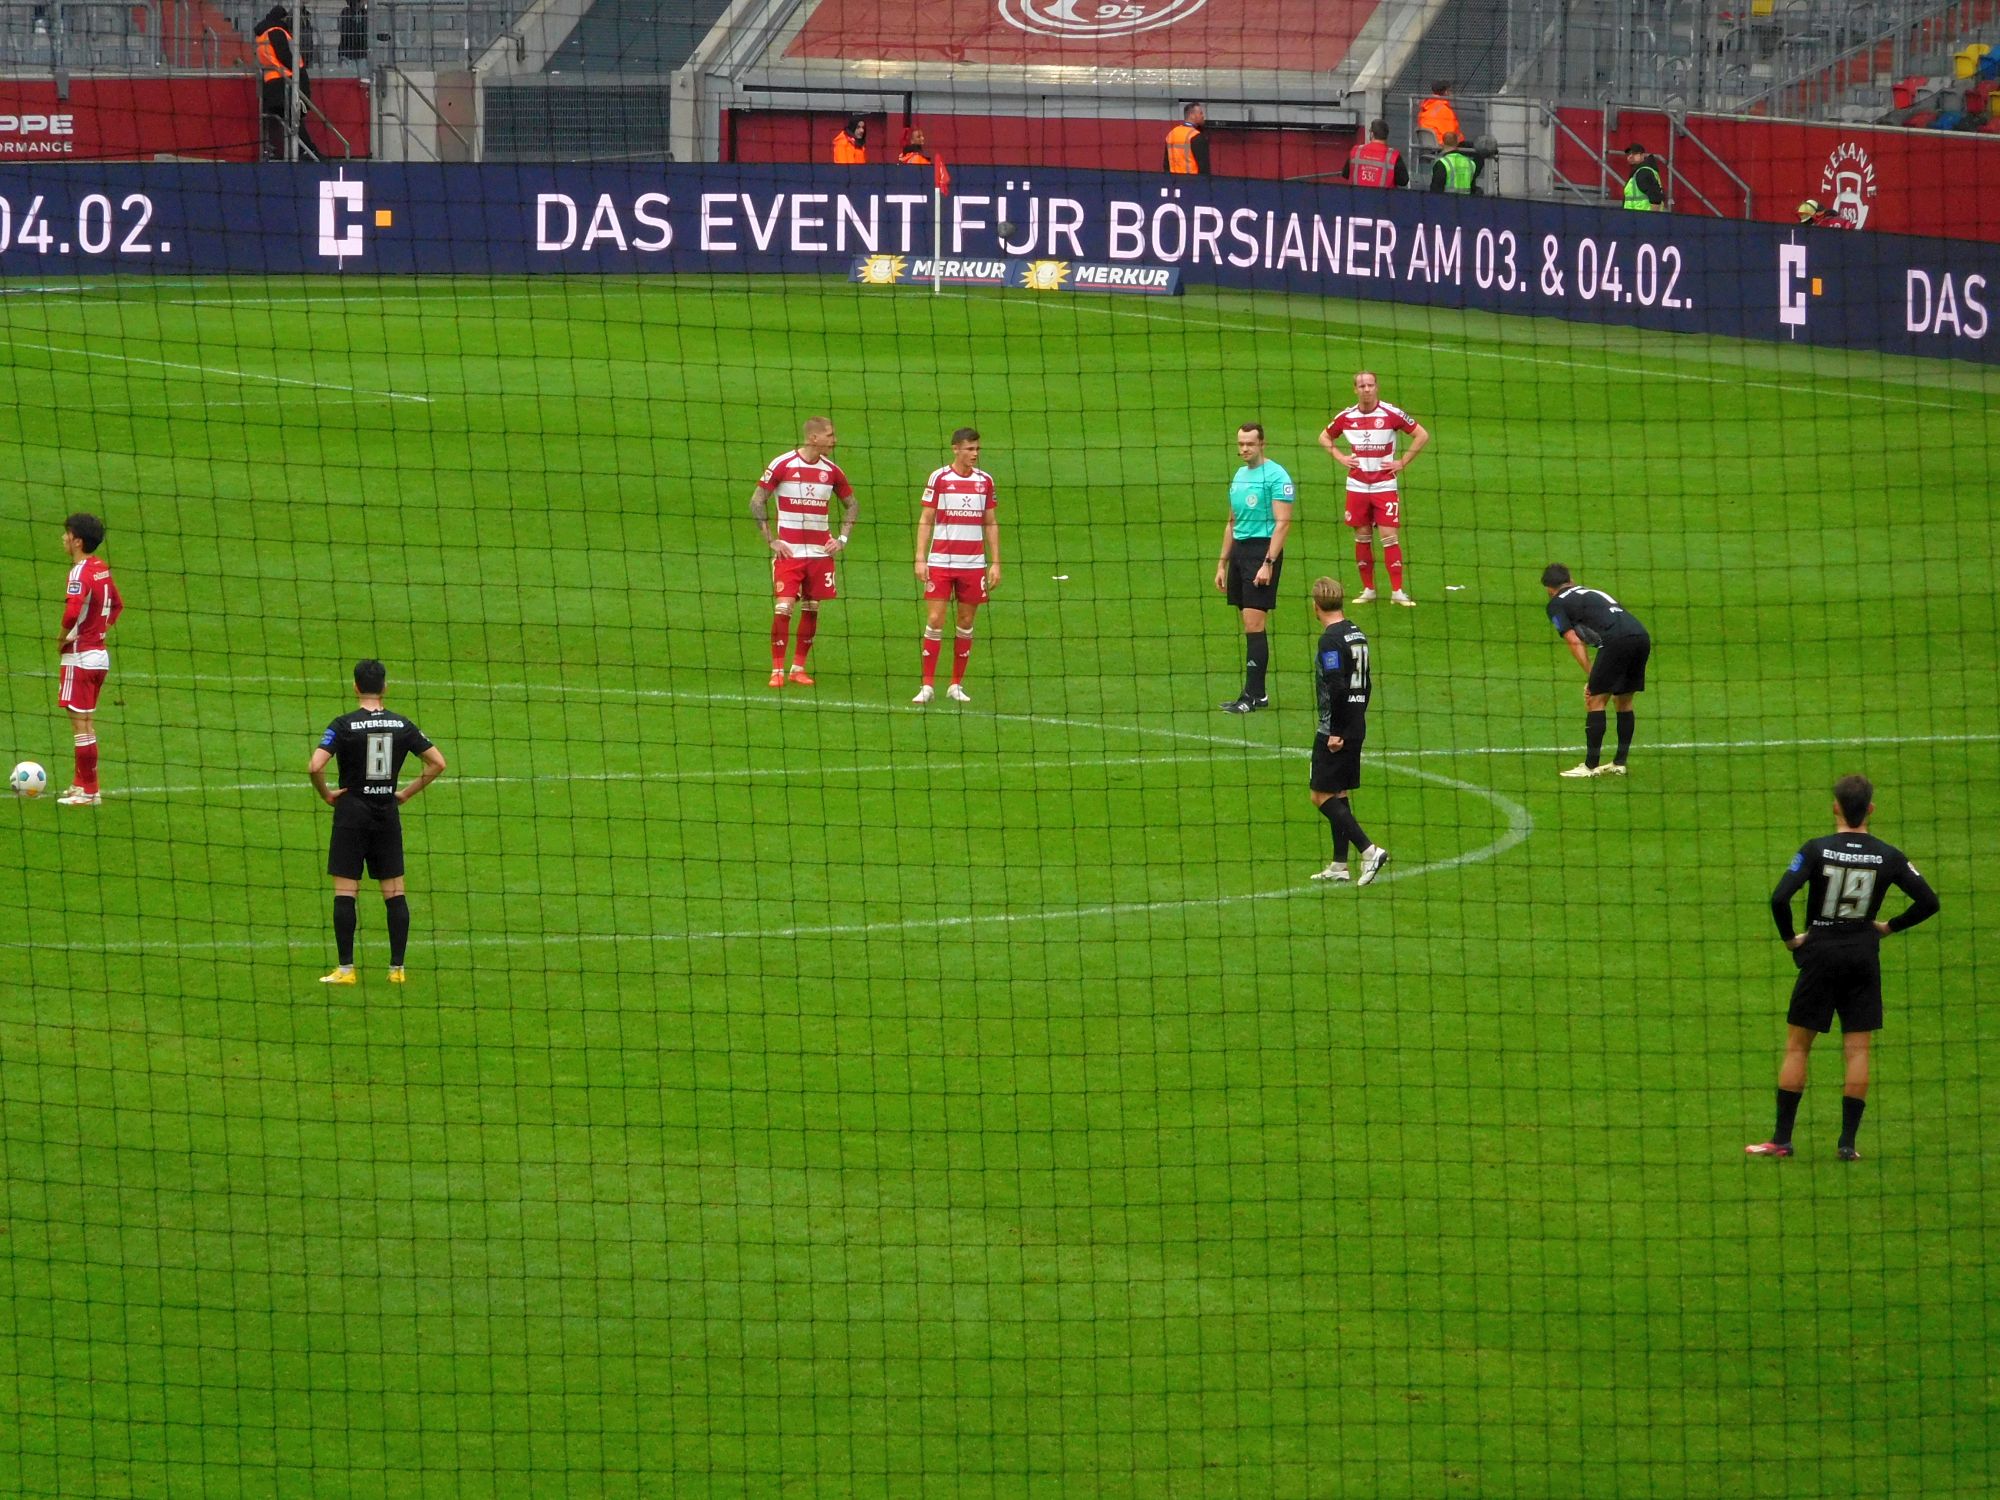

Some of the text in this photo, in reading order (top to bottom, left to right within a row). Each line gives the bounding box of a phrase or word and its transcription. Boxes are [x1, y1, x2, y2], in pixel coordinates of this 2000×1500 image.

[1094, 4, 1145, 19] 95
[1820, 142, 1877, 198] TEEKANNE
[535, 181, 1693, 310] DAS EVENT FÜR BÖRSIANER AM 03. & 04.02.
[911, 258, 1007, 280] MERKUR
[1075, 265, 1170, 287] MERKUR
[1906, 268, 1988, 339] DAS
[1384, 501, 1399, 517] 27
[350, 719, 405, 731] ELVERSBERG
[365, 732, 393, 781] 8
[363, 785, 393, 795] SAHIN
[1823, 849, 1883, 864] ELVERSBERG
[1821, 865, 1877, 919] 19
